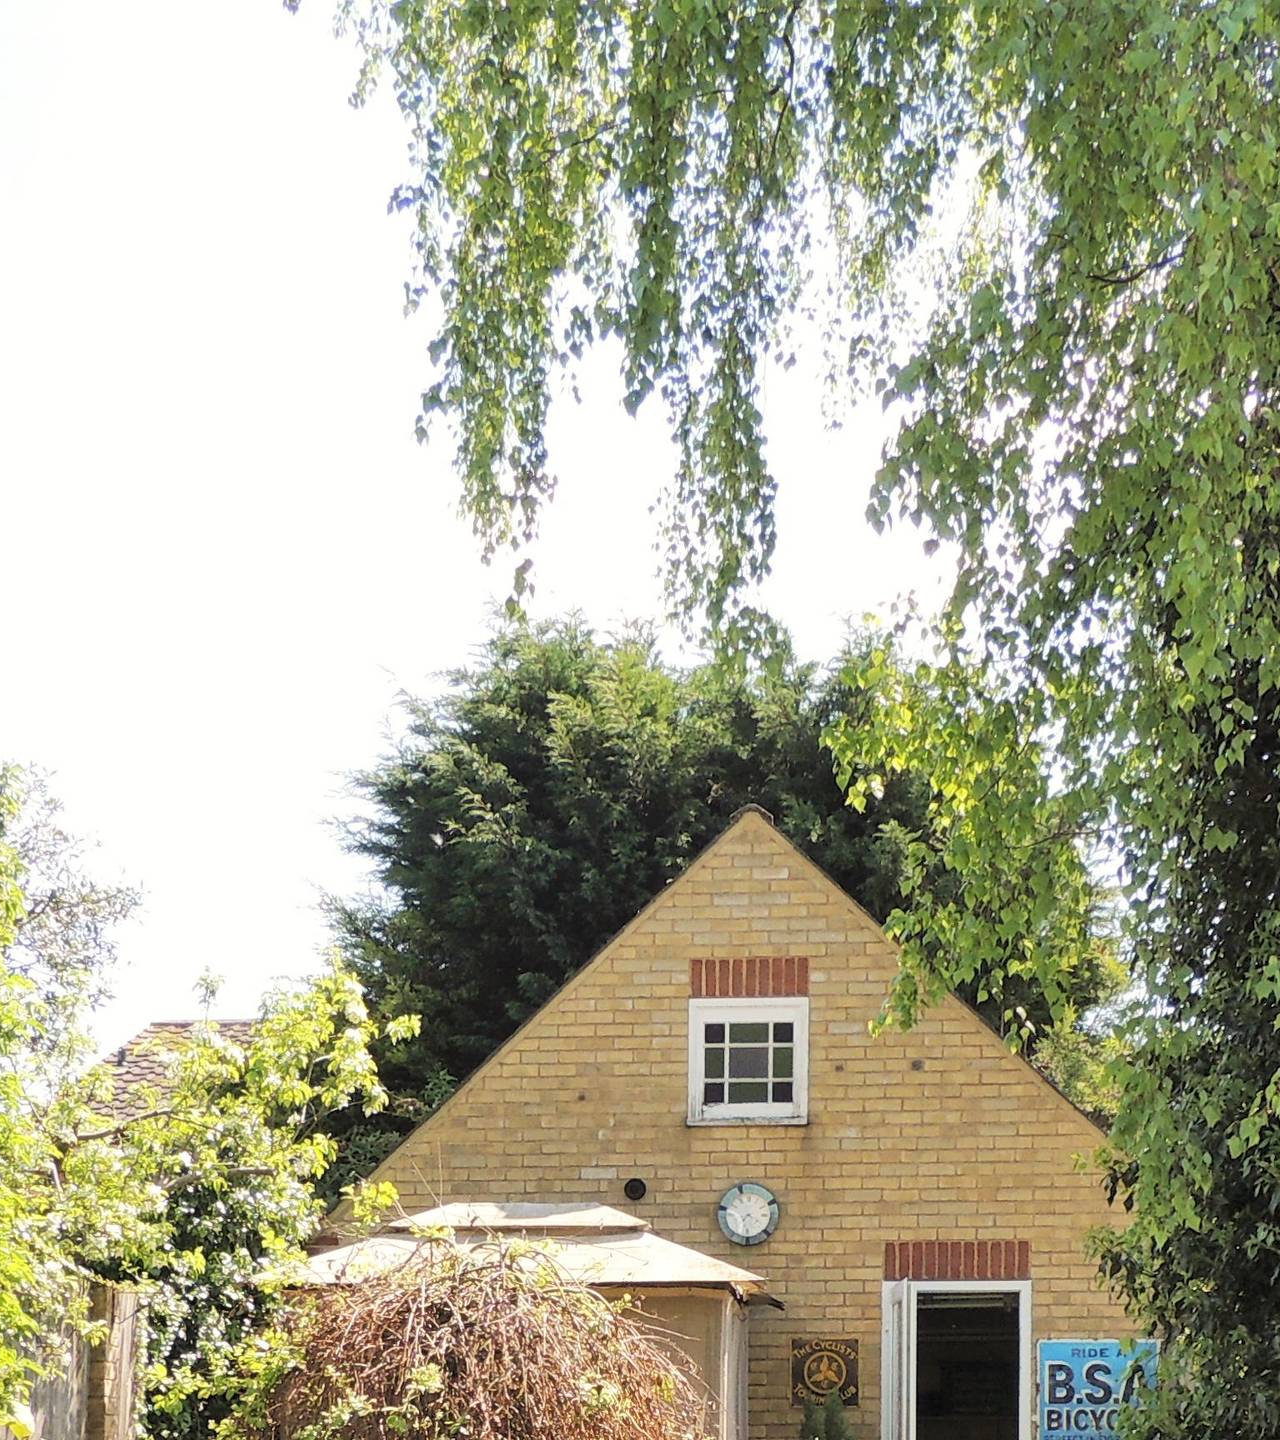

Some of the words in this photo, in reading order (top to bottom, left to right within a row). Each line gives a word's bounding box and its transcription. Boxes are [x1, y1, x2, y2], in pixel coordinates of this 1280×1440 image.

[792, 1344, 813, 1358] THE
[1072, 1348, 1109, 1358] RIDE
[1047, 1409, 1120, 1431] BICYC
